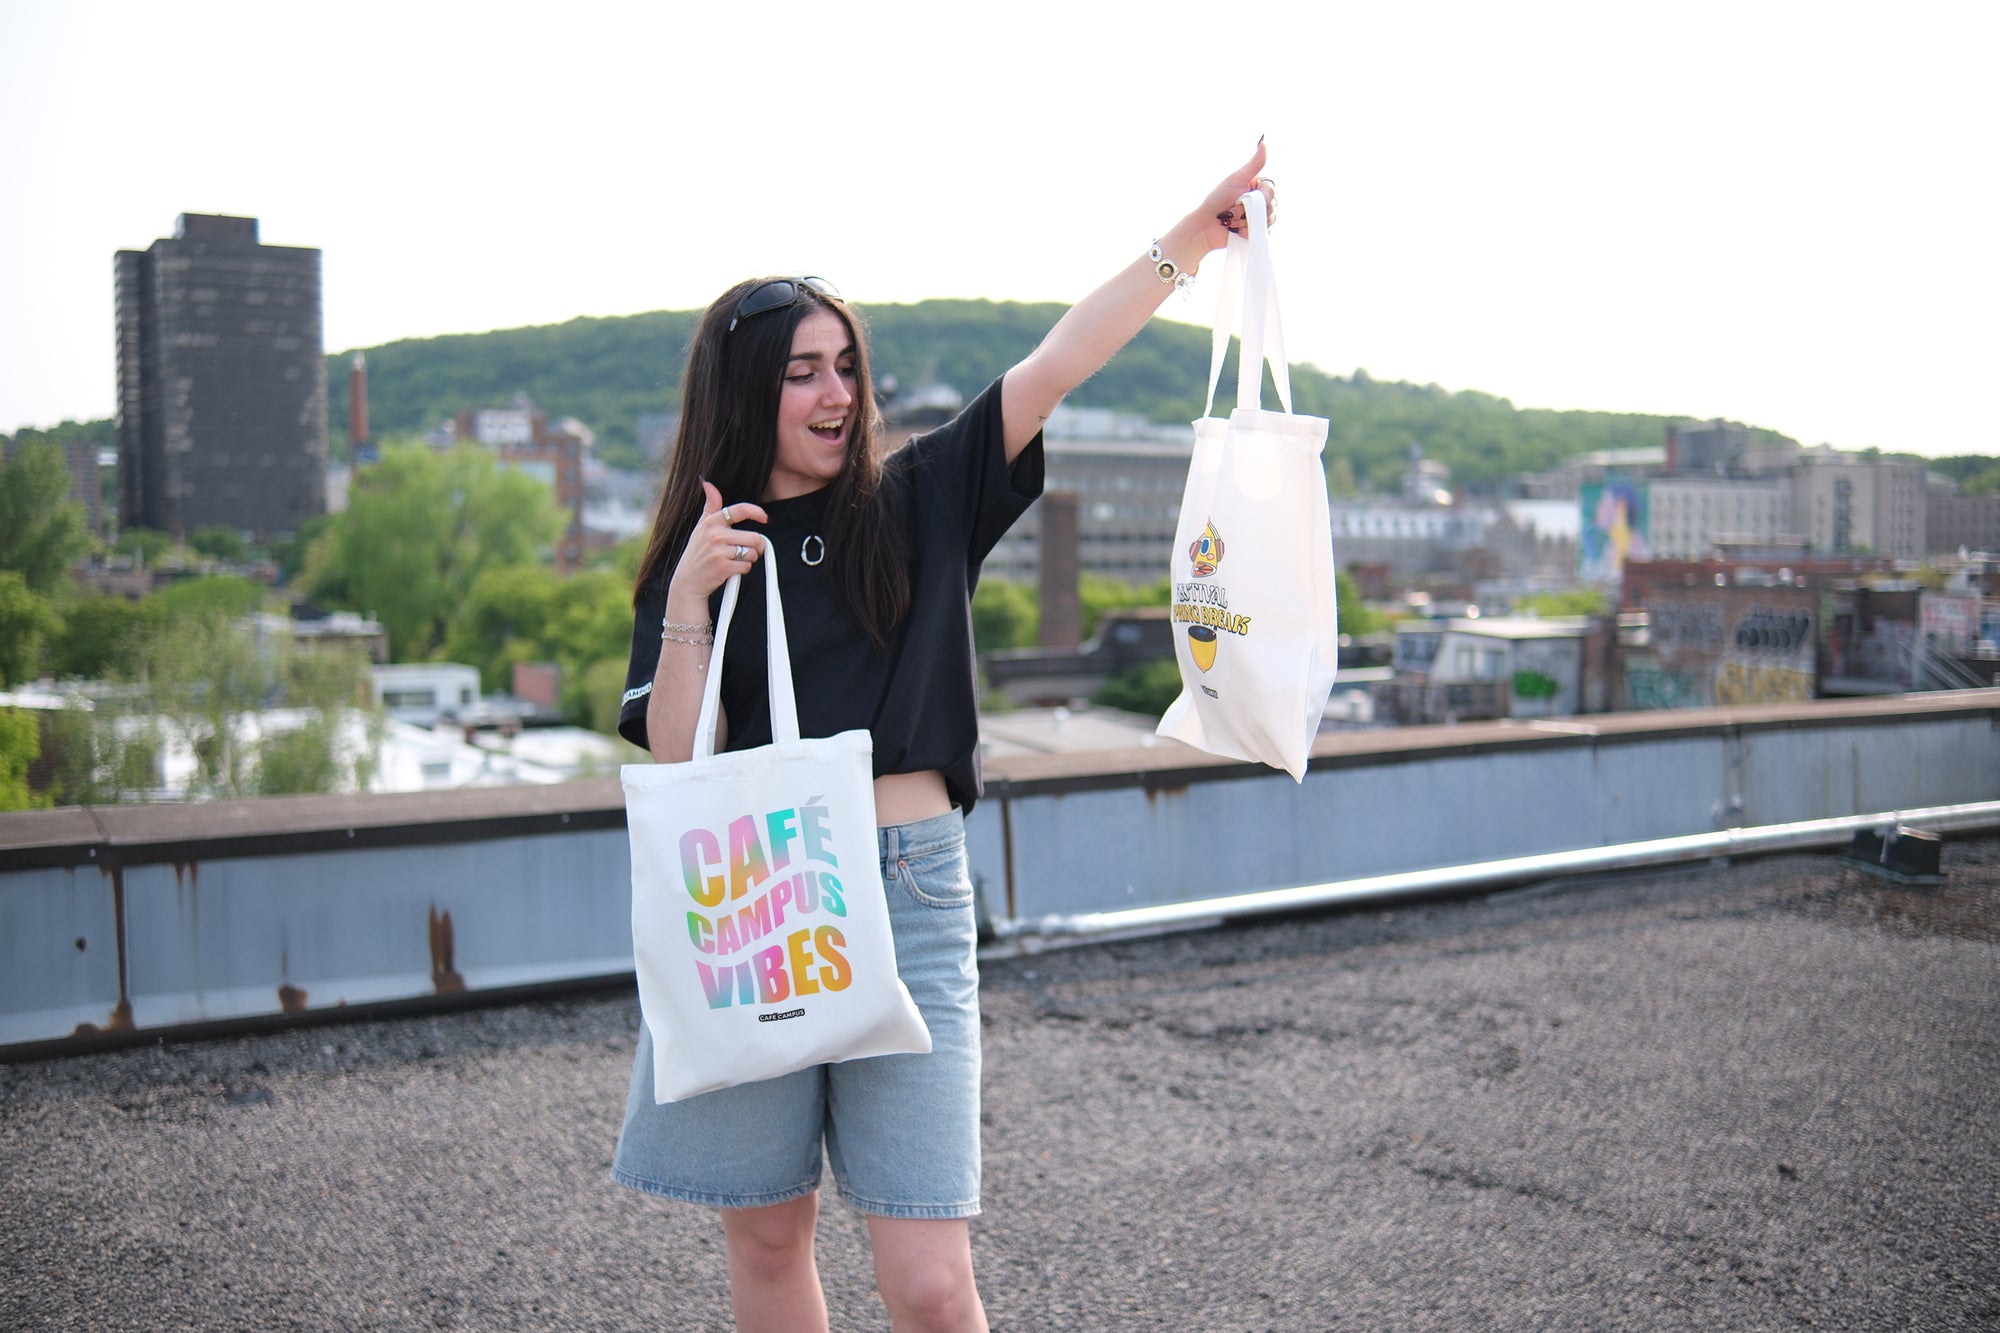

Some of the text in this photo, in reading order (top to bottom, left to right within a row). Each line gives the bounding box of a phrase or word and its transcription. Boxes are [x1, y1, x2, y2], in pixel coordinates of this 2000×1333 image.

[1201, 606, 1251, 635] BREAK
[679, 794, 838, 907] CAFÉ
[686, 870, 847, 955] CAMPUS
[695, 925, 852, 1009] VIBES
[777, 1009, 805, 1020] CAMPUS
